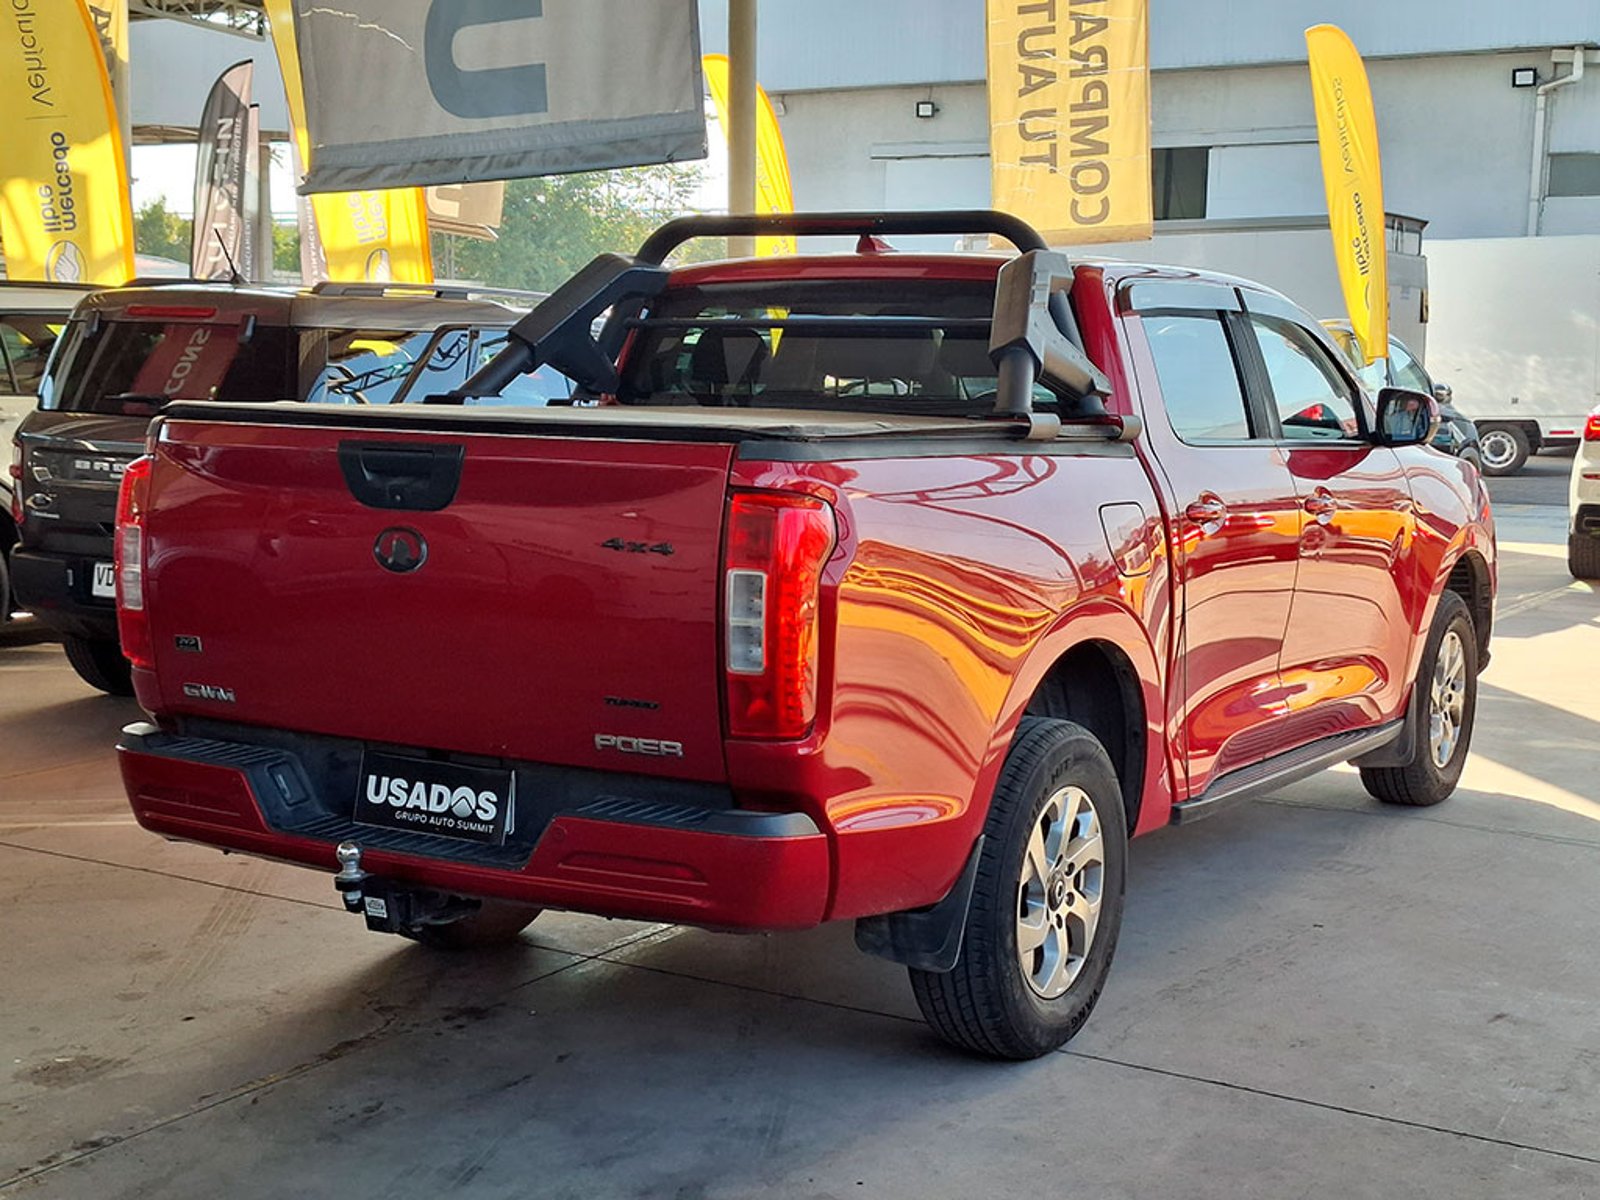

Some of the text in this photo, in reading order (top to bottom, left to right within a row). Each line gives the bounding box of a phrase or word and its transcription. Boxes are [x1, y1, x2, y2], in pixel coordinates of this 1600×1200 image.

[182, 682, 237, 704] GWM
[594, 733, 685, 758] POER
[365, 773, 499, 822] USADOS
[394, 809, 495, 834] GRUPO AUTO SUMMIT
